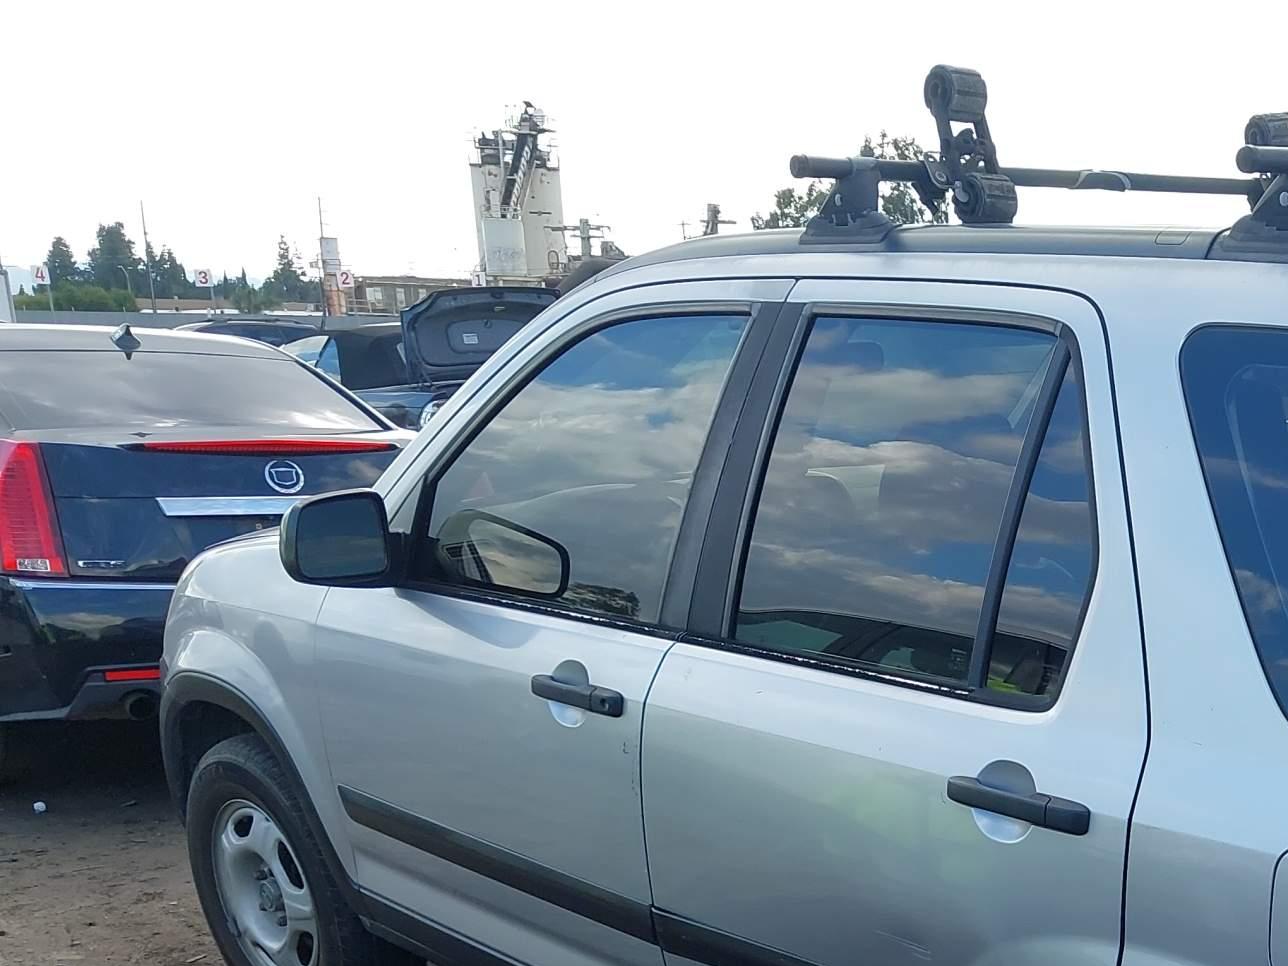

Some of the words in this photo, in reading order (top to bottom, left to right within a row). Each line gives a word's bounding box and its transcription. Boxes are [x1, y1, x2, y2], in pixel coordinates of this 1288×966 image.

[35, 267, 45, 281] 4
[198, 271, 208, 284] 3
[340, 272, 350, 285] 2
[474, 274, 482, 286] 1
